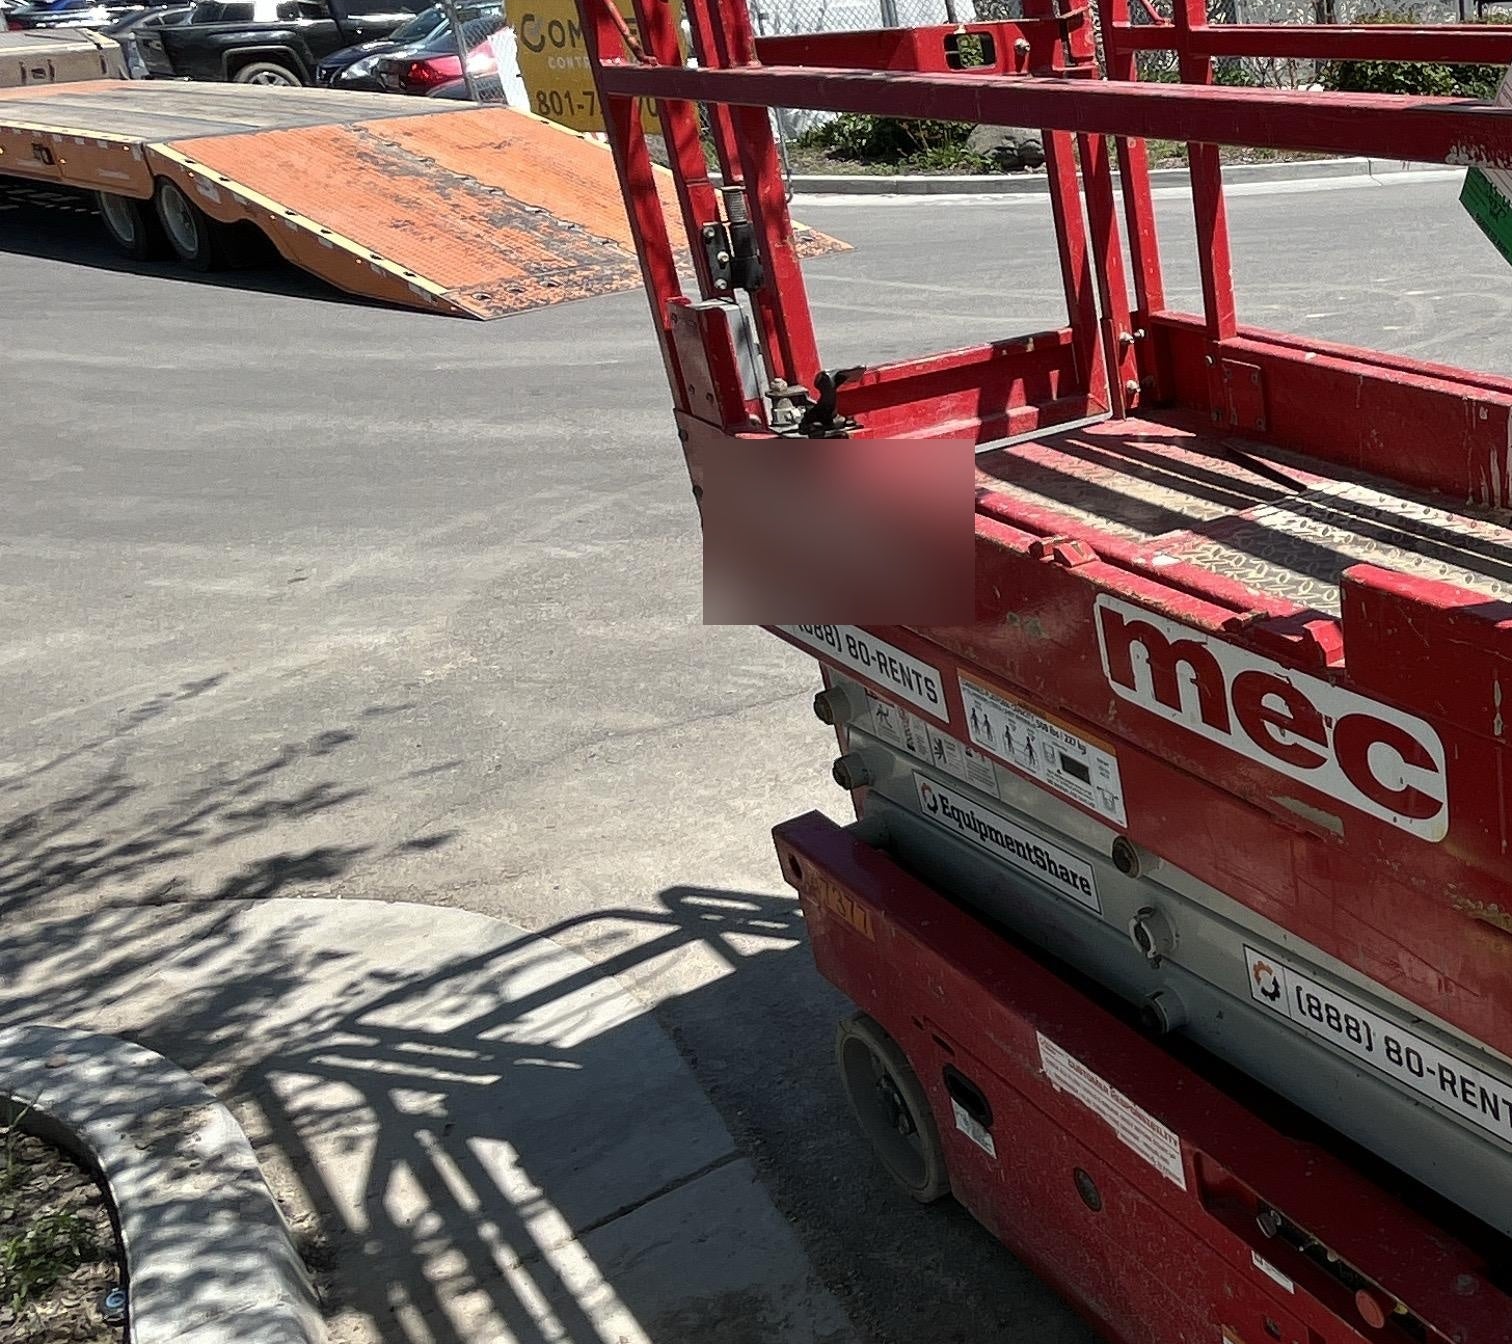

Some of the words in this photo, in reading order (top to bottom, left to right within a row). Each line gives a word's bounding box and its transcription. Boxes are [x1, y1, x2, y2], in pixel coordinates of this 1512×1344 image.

[845, 633, 939, 704] 80-RENTS
[1098, 605, 1444, 820] mec
[938, 793, 1092, 897] EquipmentShare
[1296, 985, 1375, 1052] (888)
